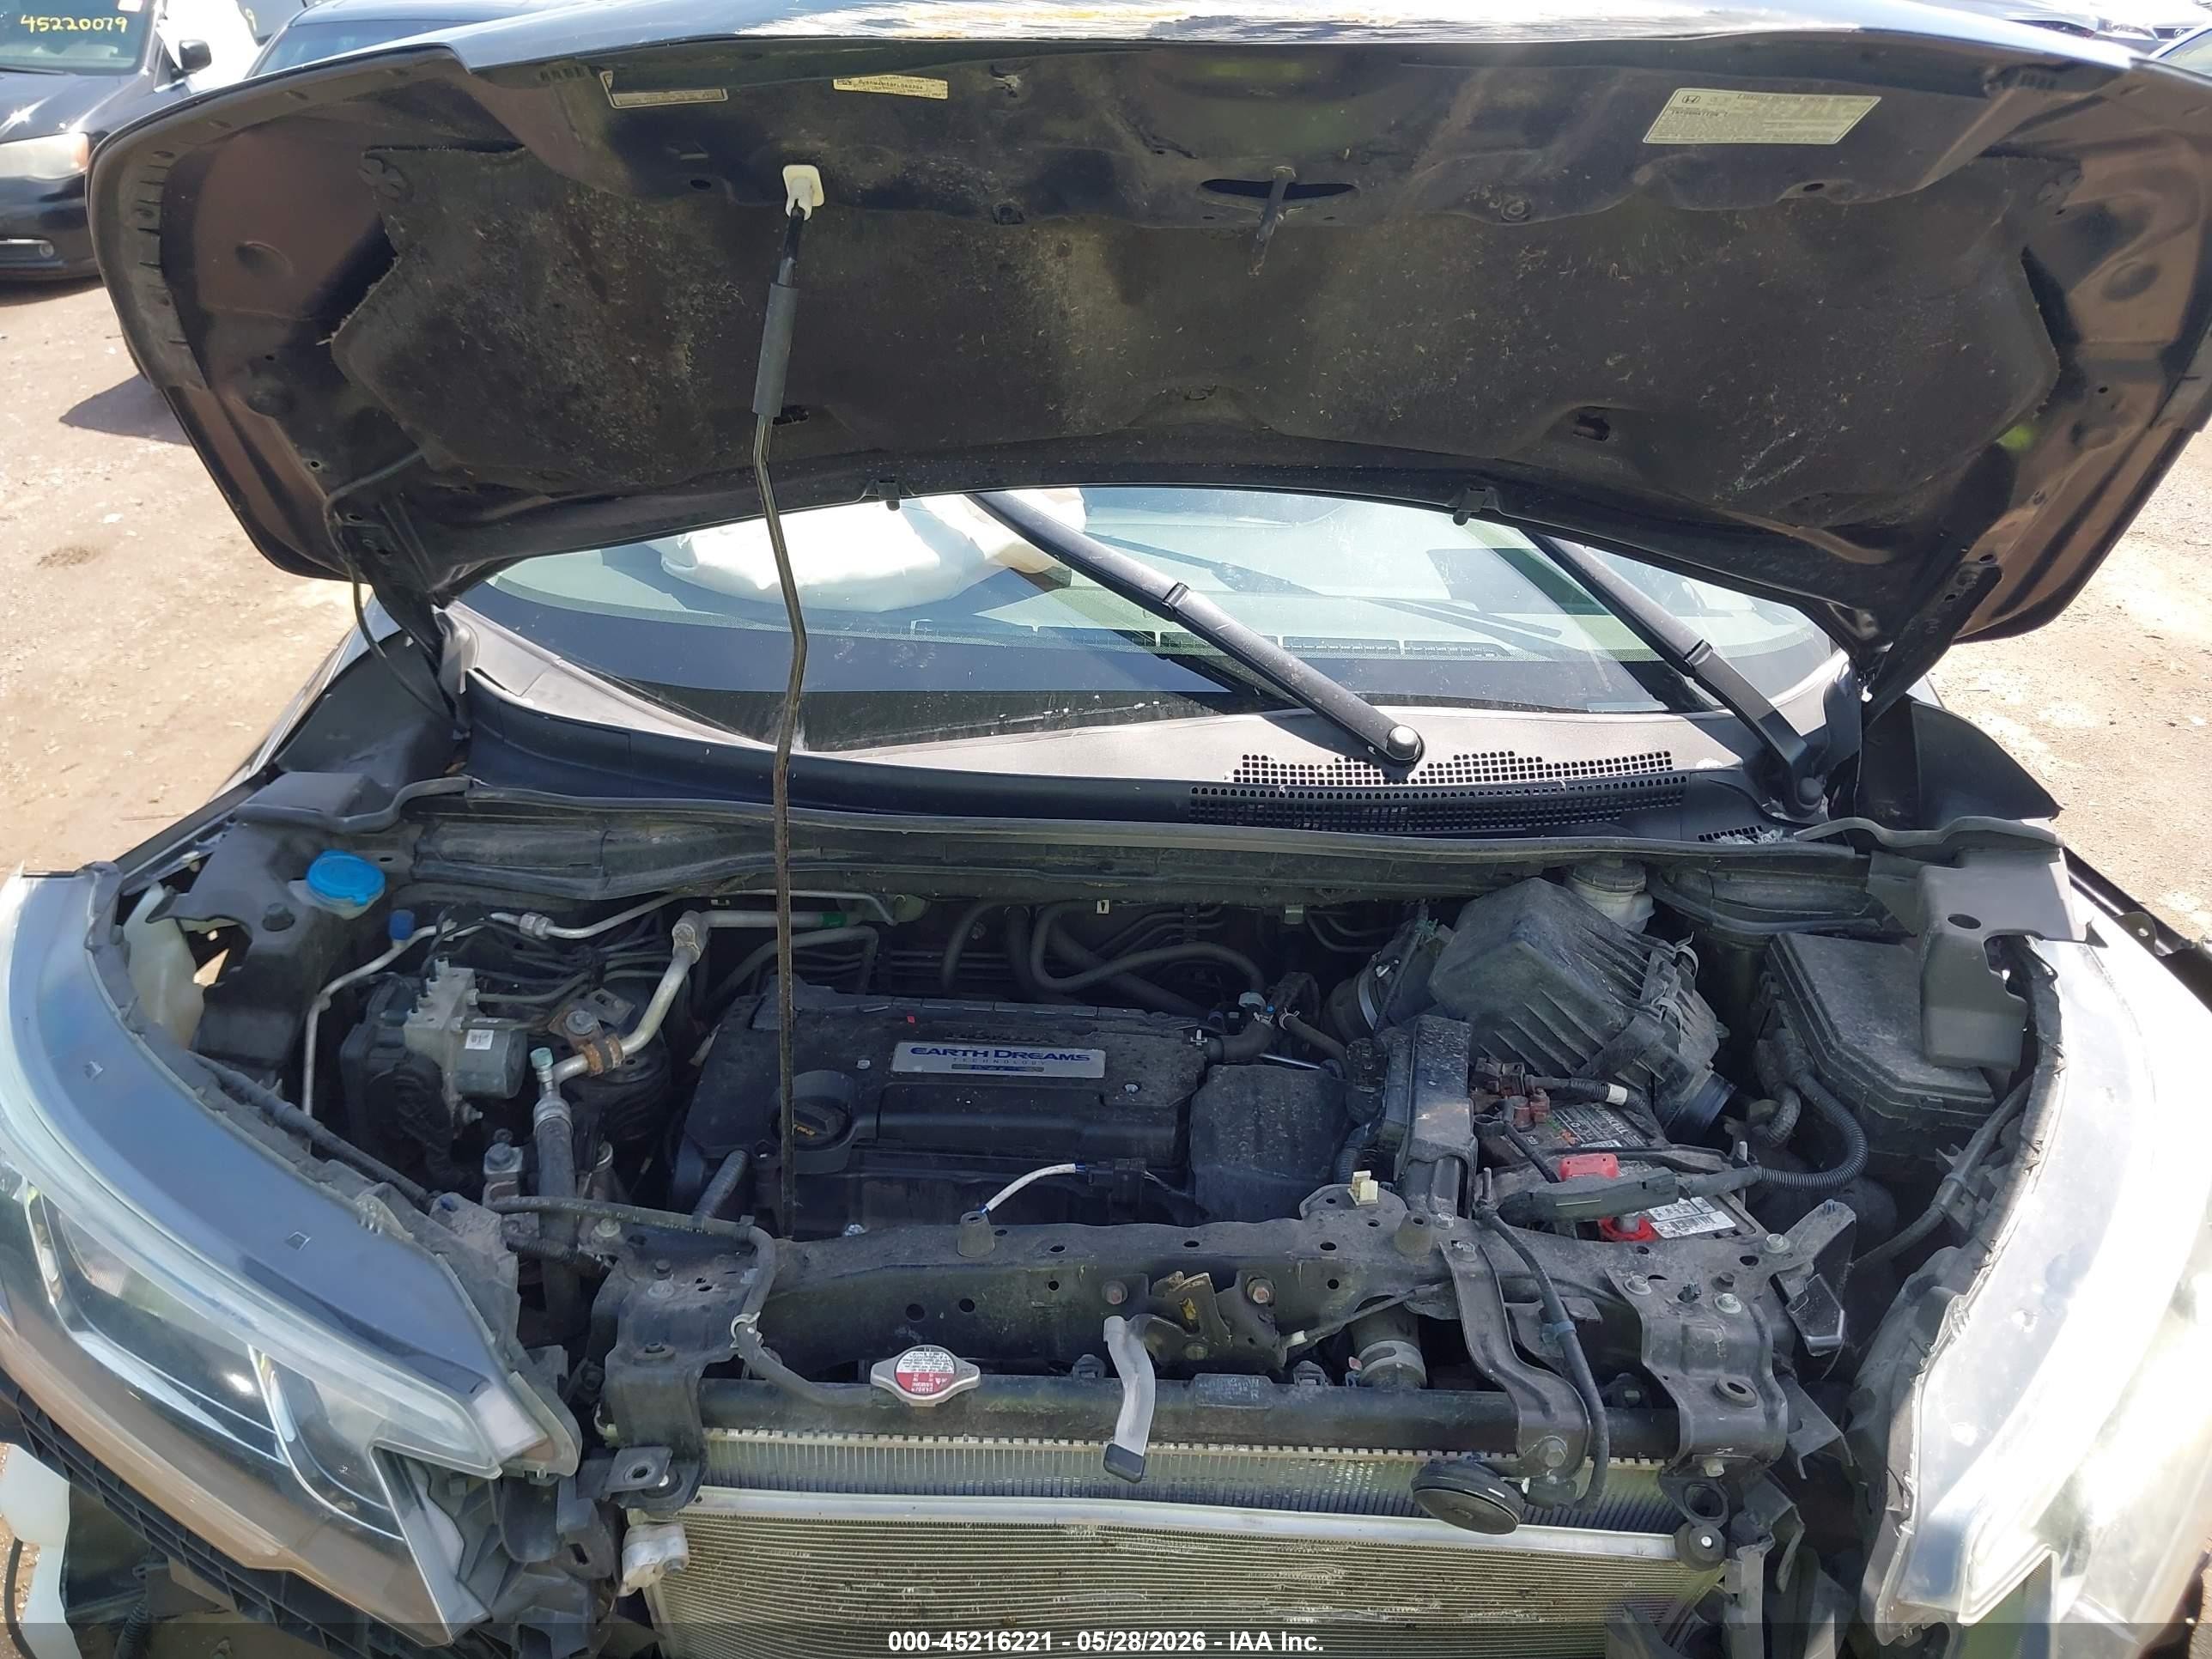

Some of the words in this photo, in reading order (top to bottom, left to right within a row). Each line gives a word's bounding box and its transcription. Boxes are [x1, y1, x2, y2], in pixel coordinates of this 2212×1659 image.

[20, 14, 129, 34] 45220079
[909, 1047, 989, 1058] EARTH
[994, 1048, 1091, 1062] DREAMS
[1589, 1102, 1630, 1135] DURACELL
